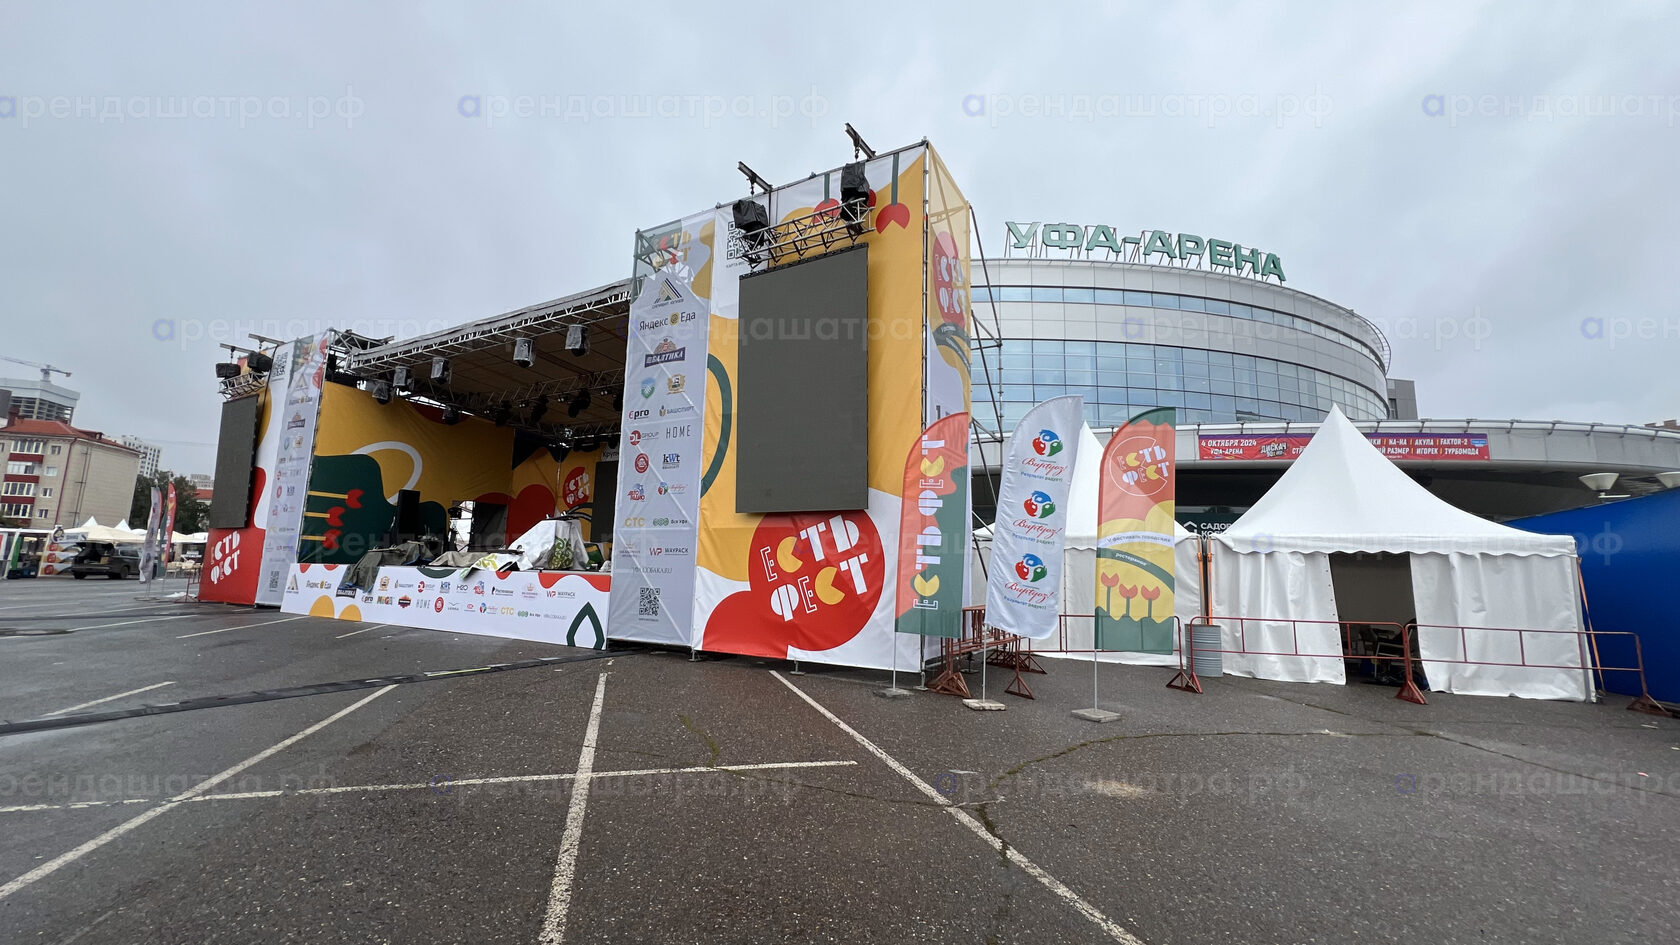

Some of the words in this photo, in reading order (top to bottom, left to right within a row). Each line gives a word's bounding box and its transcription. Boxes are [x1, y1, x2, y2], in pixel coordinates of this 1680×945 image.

[1005, 221, 1286, 282] УФА-АРЕНА
[639, 318, 669, 331] Яндекс
[680, 311, 696, 322] Еда
[665, 424, 692, 439] HOME
[1240, 439, 1257, 447] 2024
[1414, 438, 1434, 446] АКУЛА
[1387, 447, 1410, 455] РАЗМЕР
[760, 514, 860, 583] ЕСТЬ
[770, 552, 870, 622] ФЕСТ
